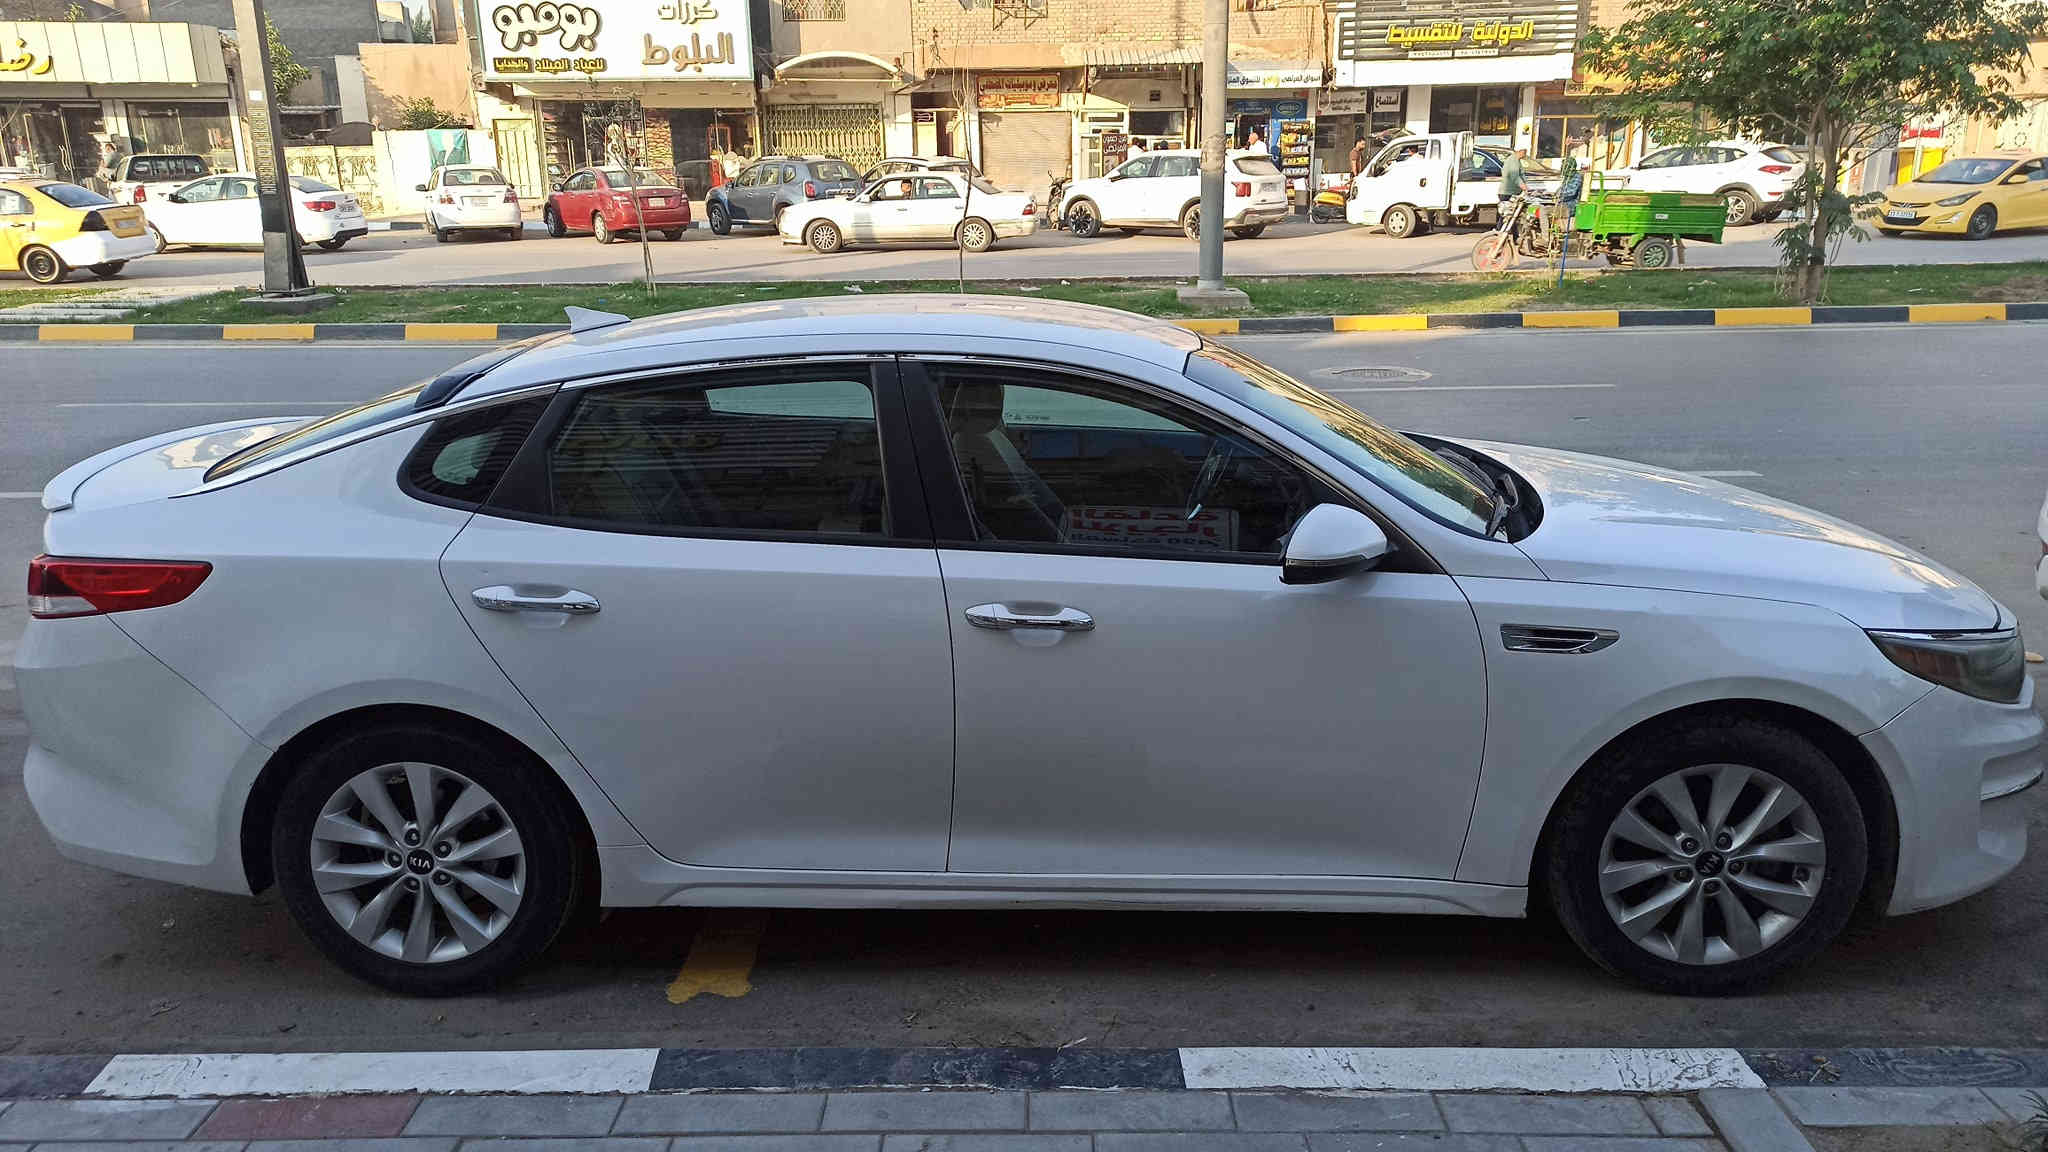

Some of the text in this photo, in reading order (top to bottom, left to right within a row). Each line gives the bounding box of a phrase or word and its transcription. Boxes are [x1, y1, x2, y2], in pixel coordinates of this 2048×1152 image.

[492, 1, 603, 51] بومبو
[1385, 20, 1535, 49] الدولية للتقسيط
[642, 31, 735, 72] البلوط
[410, 856, 431, 869] KIA
